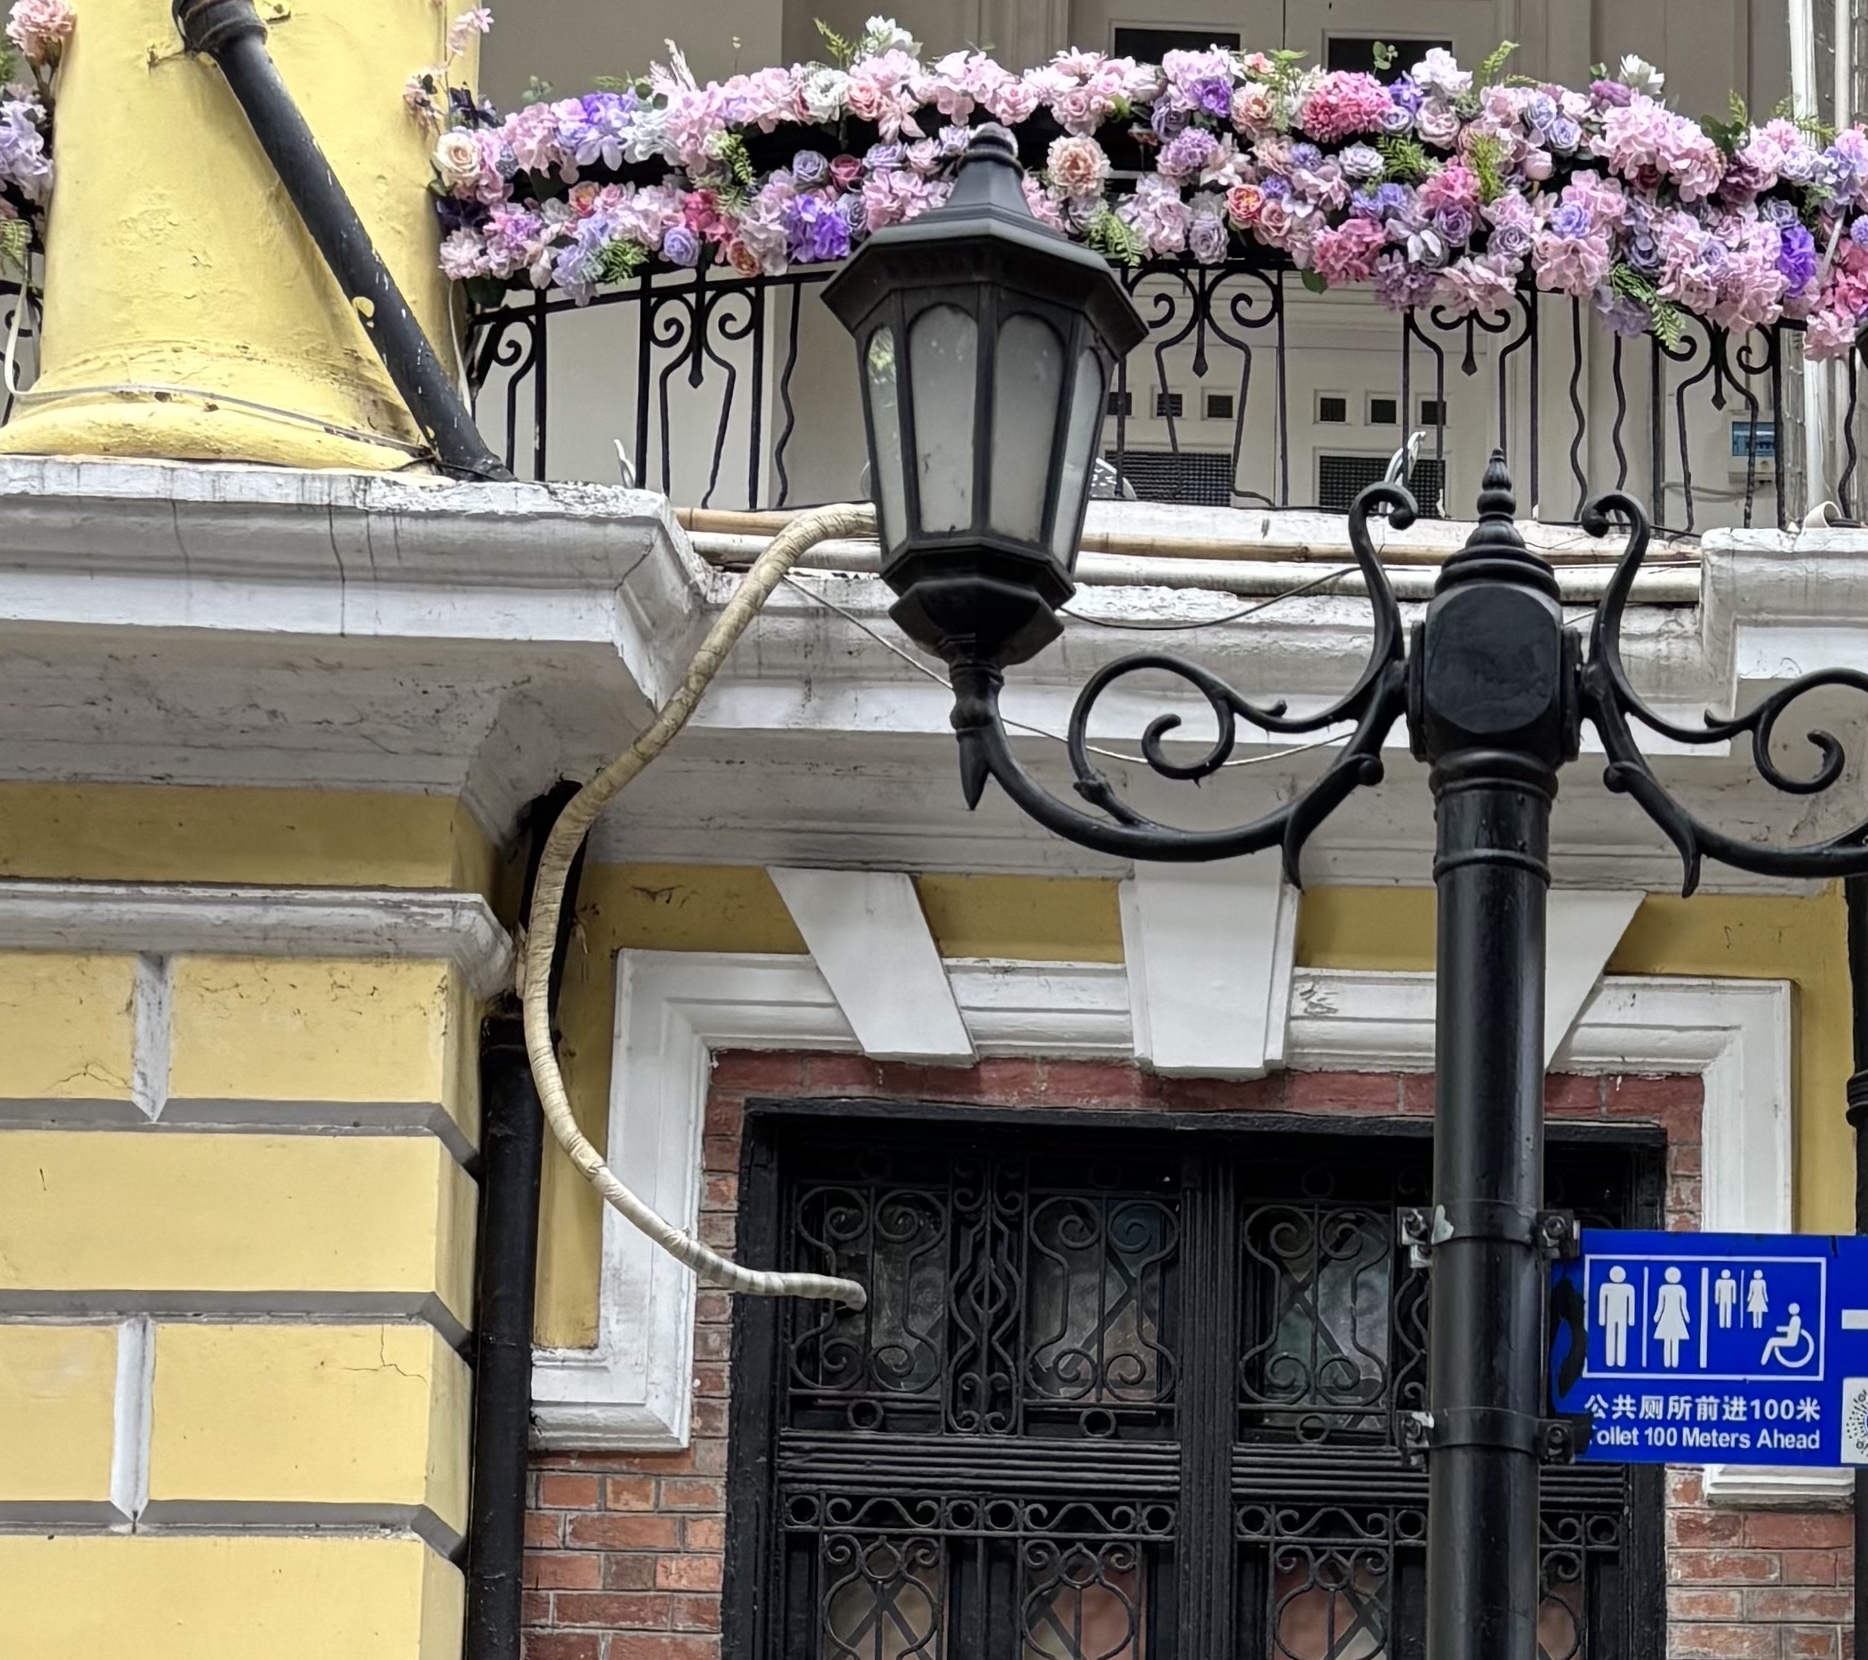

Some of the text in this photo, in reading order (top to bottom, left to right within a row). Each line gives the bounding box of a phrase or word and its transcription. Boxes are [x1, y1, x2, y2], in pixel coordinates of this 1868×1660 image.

[1584, 1393, 1821, 1423] 公共厕所前进100米
[1644, 1426, 1678, 1447] 100
[1682, 1426, 1752, 1449] Meters
[1756, 1428, 1821, 1449] Ahead
